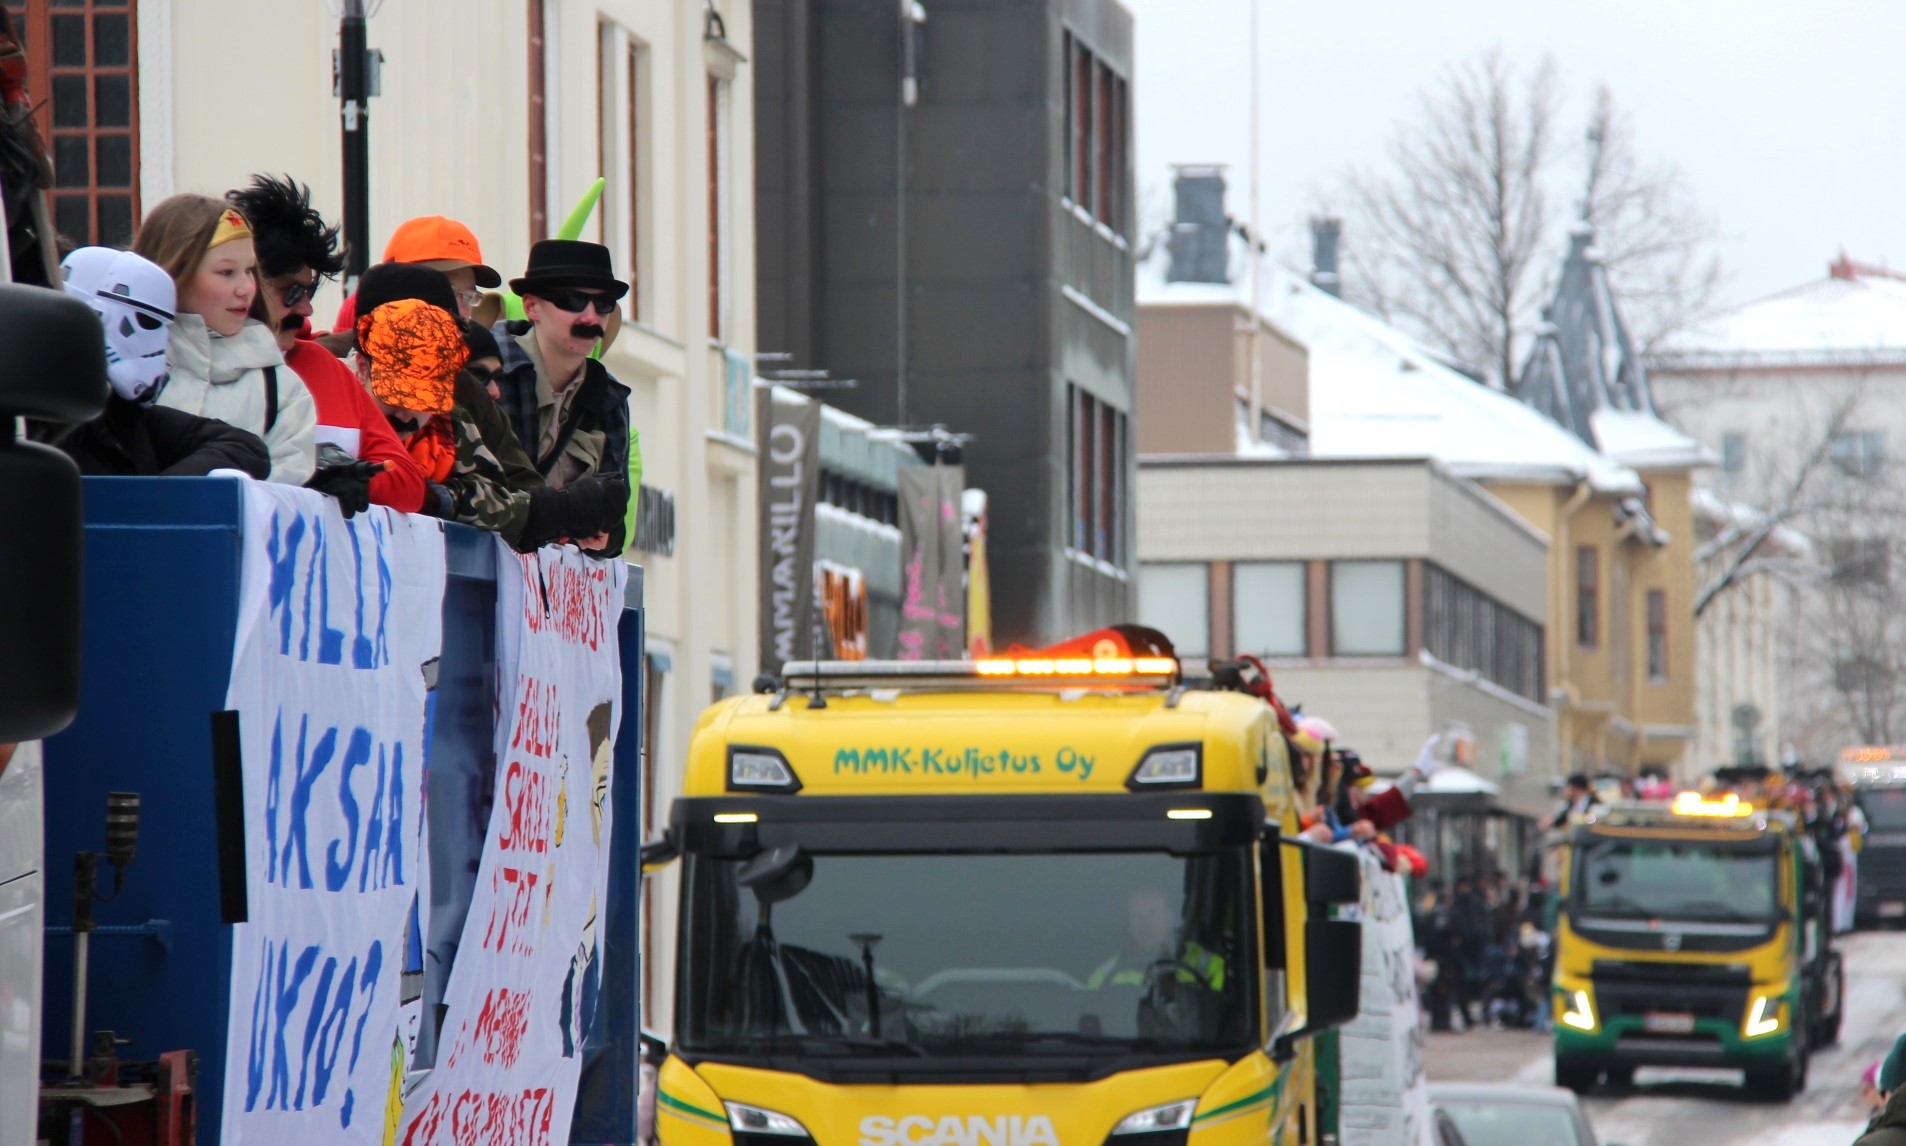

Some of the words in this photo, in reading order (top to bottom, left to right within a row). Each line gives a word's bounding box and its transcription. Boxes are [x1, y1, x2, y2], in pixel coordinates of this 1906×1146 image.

[834, 746, 1041, 779] MMK-Kuljetus
[1055, 747, 1095, 780] Oy
[858, 1115, 1060, 1146] SCANIA
